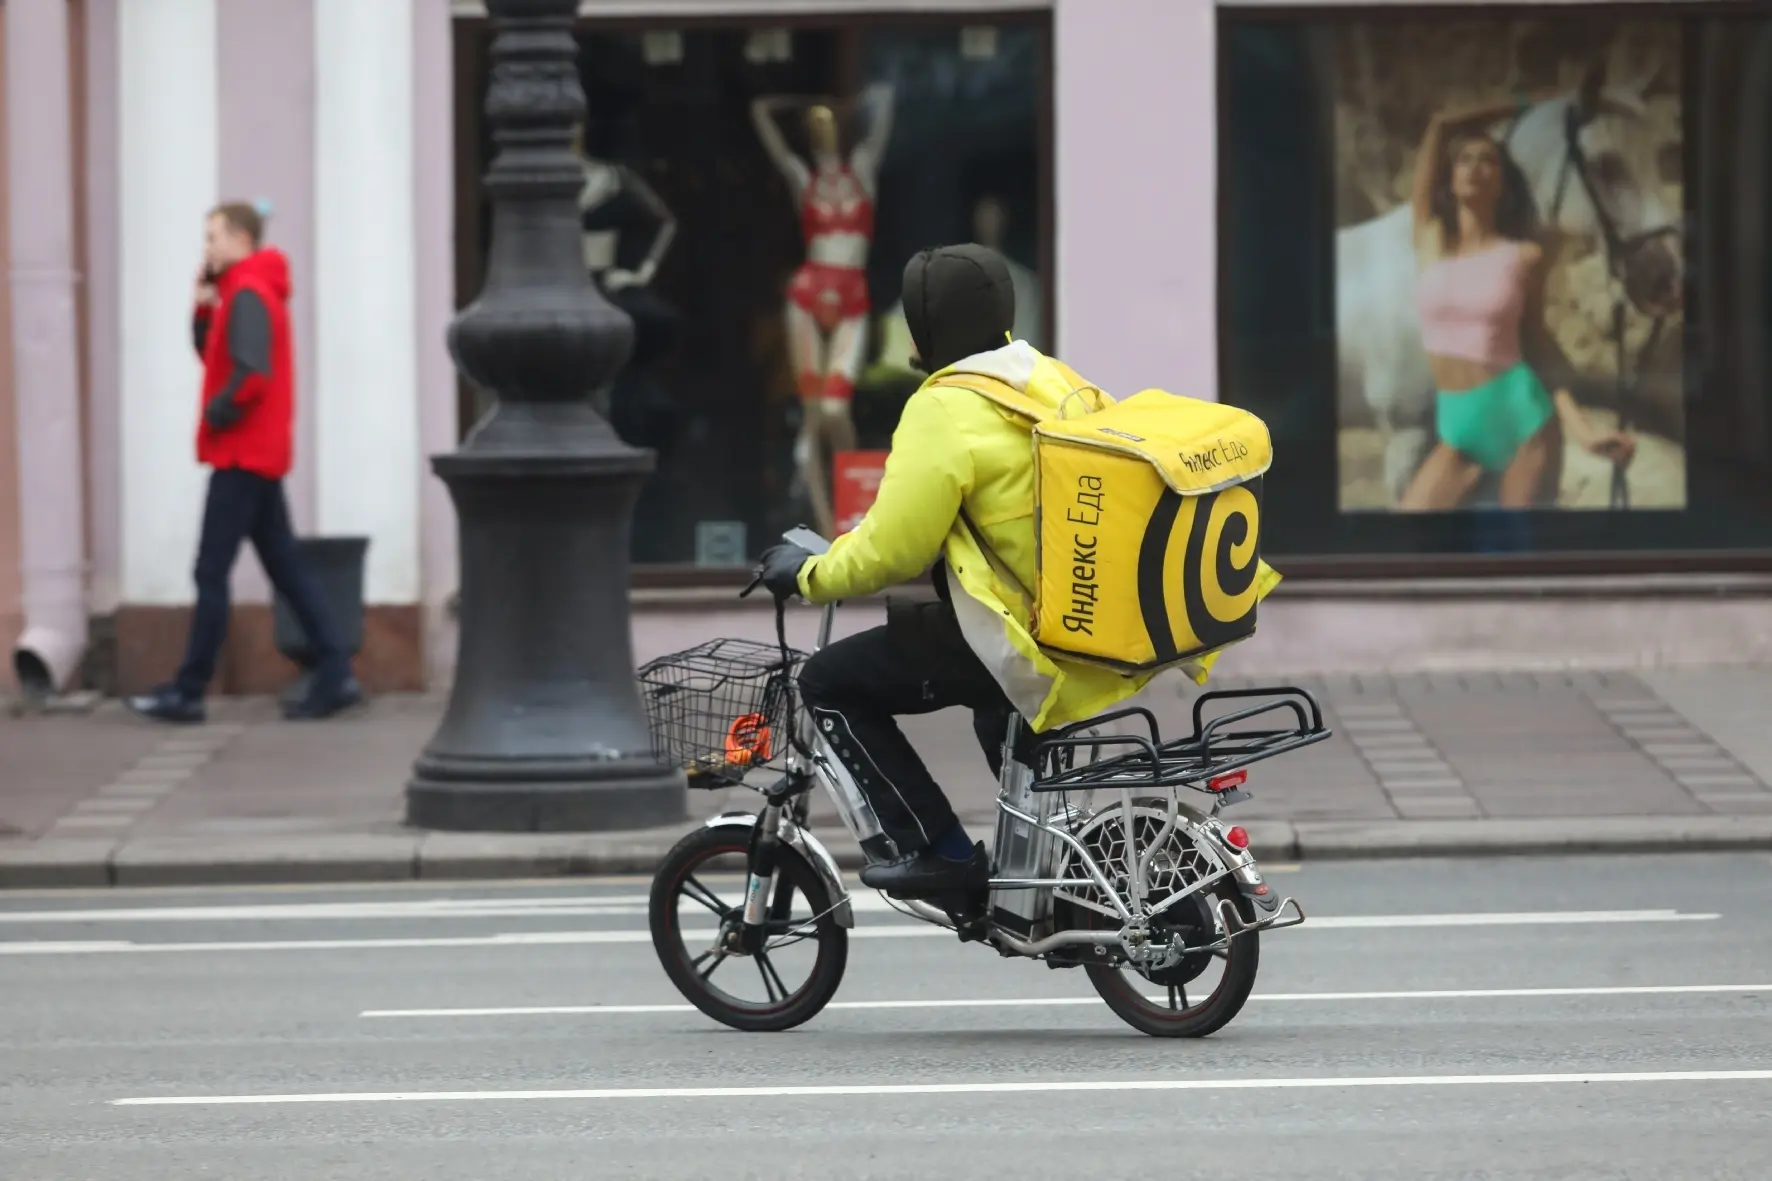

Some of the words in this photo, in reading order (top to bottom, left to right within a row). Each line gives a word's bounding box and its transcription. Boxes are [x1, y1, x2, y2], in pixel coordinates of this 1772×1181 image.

[1217, 439, 1249, 462] Еда
[1066, 475, 1106, 526] Еда
[1062, 533, 1099, 637] Яндекс
